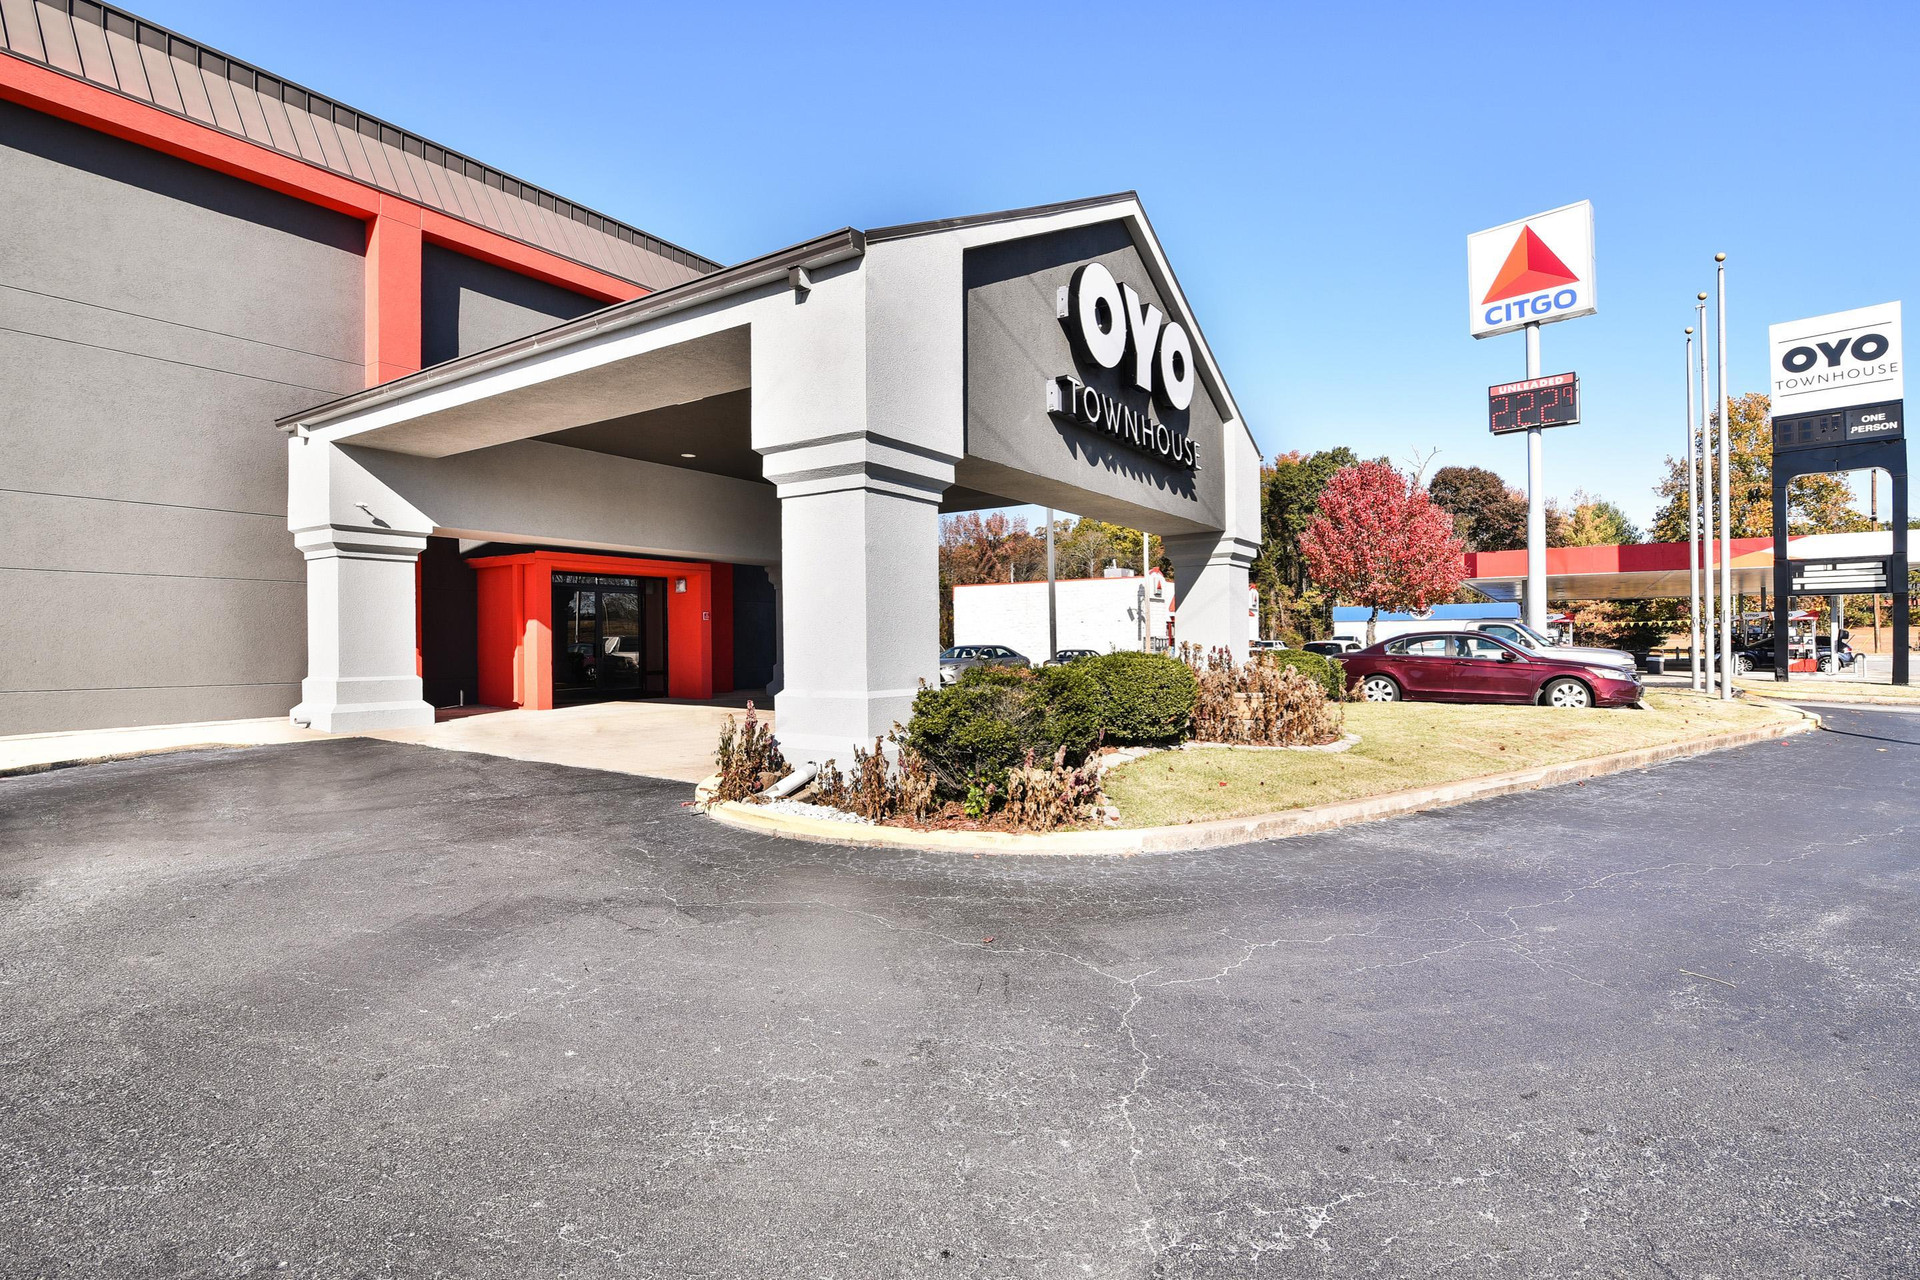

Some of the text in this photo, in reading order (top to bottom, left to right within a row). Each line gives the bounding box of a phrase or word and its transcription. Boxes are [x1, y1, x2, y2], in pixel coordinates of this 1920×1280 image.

[1485, 289, 1577, 325] CITGO
[1069, 262, 1195, 410] OYO
[1782, 333, 1889, 373] OYO
[1499, 376, 1563, 394] UNLEADED
[1775, 362, 1899, 390] TOWNHOUSE
[1058, 375, 1202, 470] TOWNHOUSE
[1850, 421, 1897, 433] PERSON
[1861, 413, 1886, 423] ONE
